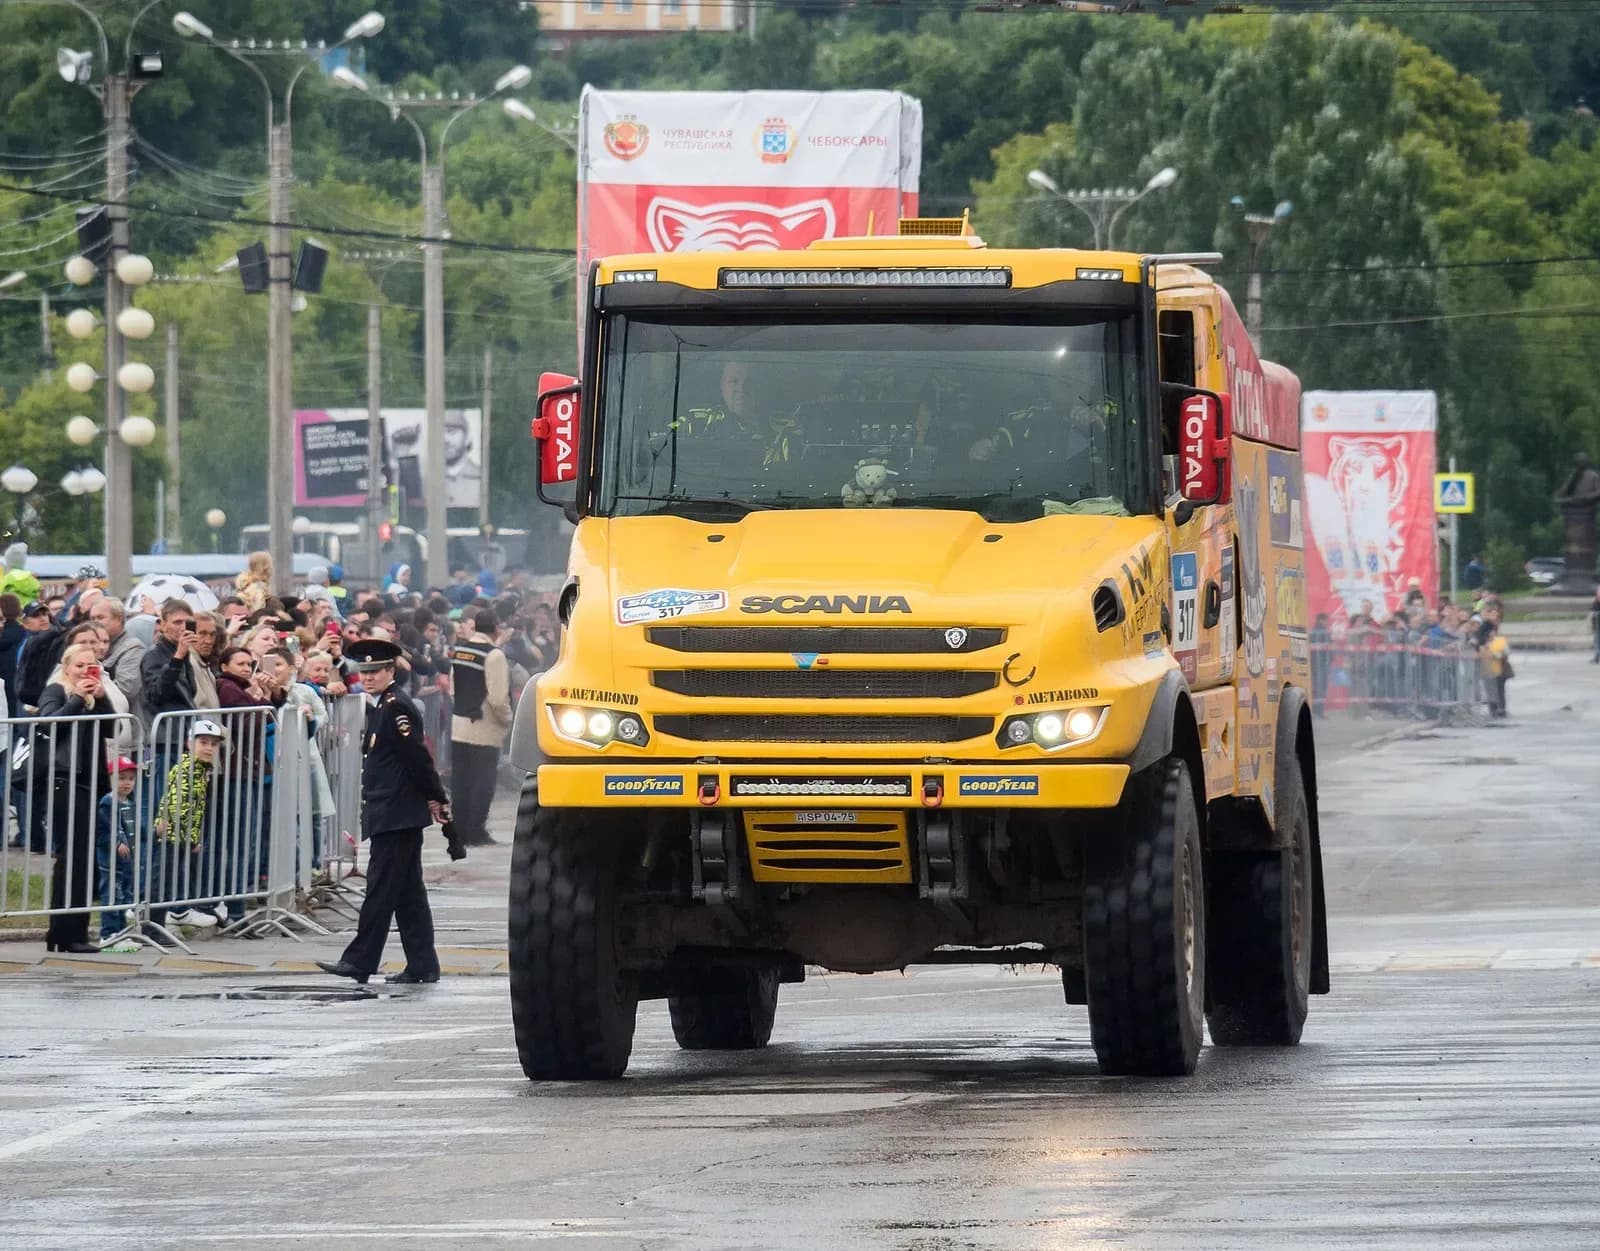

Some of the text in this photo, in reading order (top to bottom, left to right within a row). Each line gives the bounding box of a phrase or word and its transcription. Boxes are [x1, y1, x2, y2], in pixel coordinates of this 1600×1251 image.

[662, 128, 733, 139] ЧУВАШСКАЯ
[663, 140, 733, 151] РЕСПУБЛИКА
[808, 135, 888, 147] ЧЕБОКСАРЫ
[1186, 398, 1207, 498] TOTAL
[740, 595, 912, 614] SCANIA
[658, 606, 684, 618] 317
[1179, 598, 1195, 642] 317
[570, 688, 639, 706] METABOND
[1028, 687, 1099, 705] METABOND
[607, 778, 681, 792] GOODYEAR
[962, 779, 1036, 792] GOODYEAR
